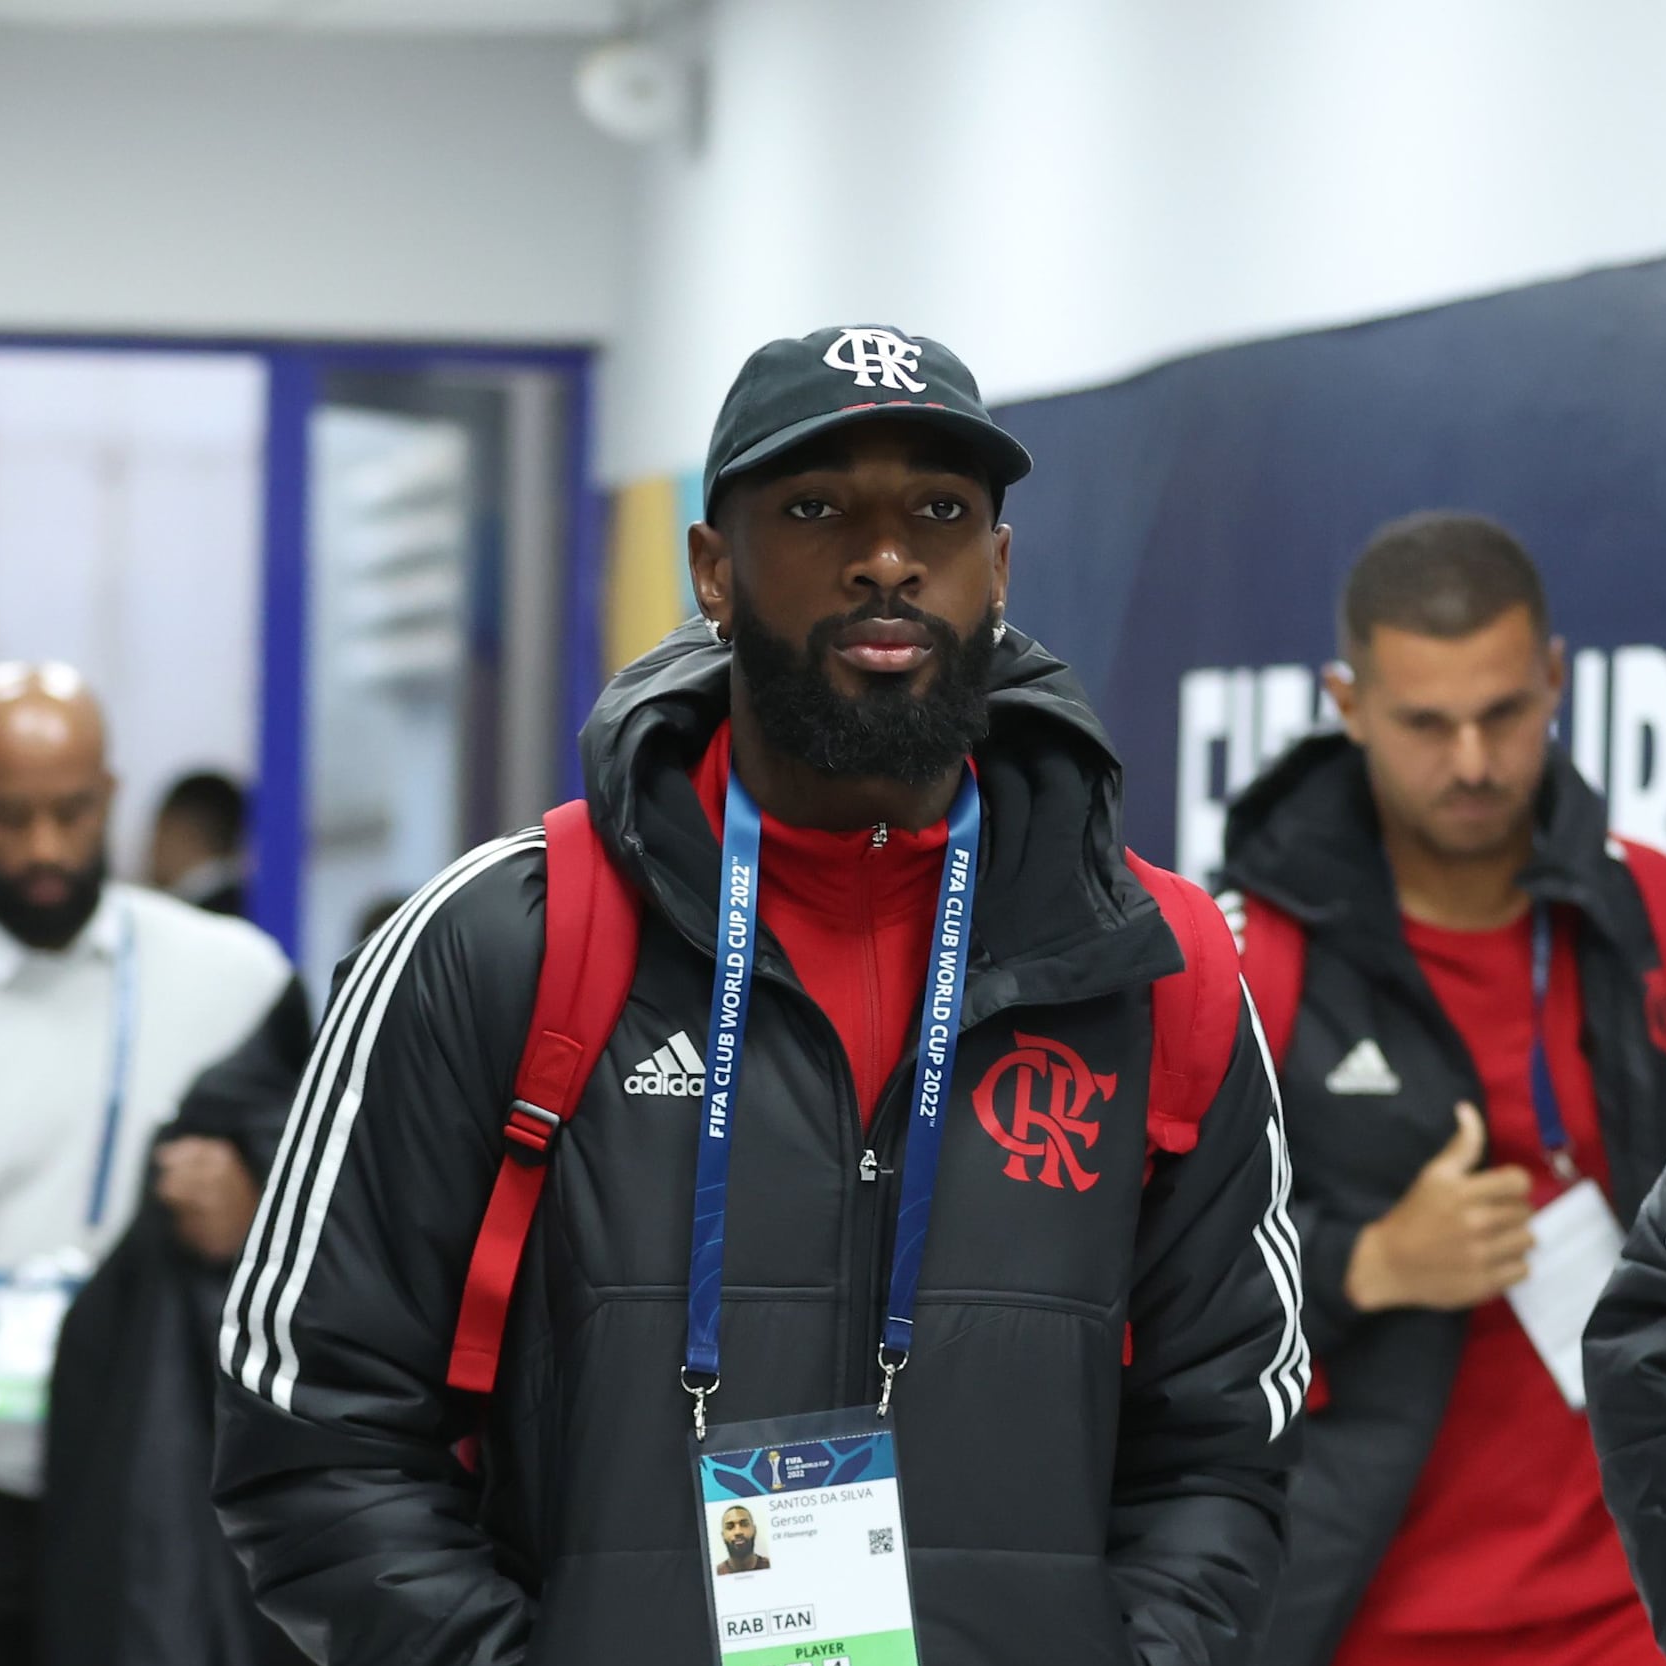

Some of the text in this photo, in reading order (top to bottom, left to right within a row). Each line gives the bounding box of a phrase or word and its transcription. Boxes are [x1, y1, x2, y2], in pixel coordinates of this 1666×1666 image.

[948, 848, 969, 892] FIFA
[728, 911, 748, 949] CUP
[942, 897, 963, 947] CLUB
[720, 953, 744, 1028] WORLD
[933, 950, 958, 1021] WORLD
[715, 1032, 734, 1086] CLUB
[928, 1024, 949, 1065] CUP
[624, 1071, 706, 1097] adida
[709, 1092, 727, 1138] FIFA
[769, 1488, 874, 1511] SANTOS DA SILVA
[771, 1513, 814, 1528] Gerson
[727, 1611, 812, 1637] RAB TAN
[795, 1642, 845, 1659] PLAYER
